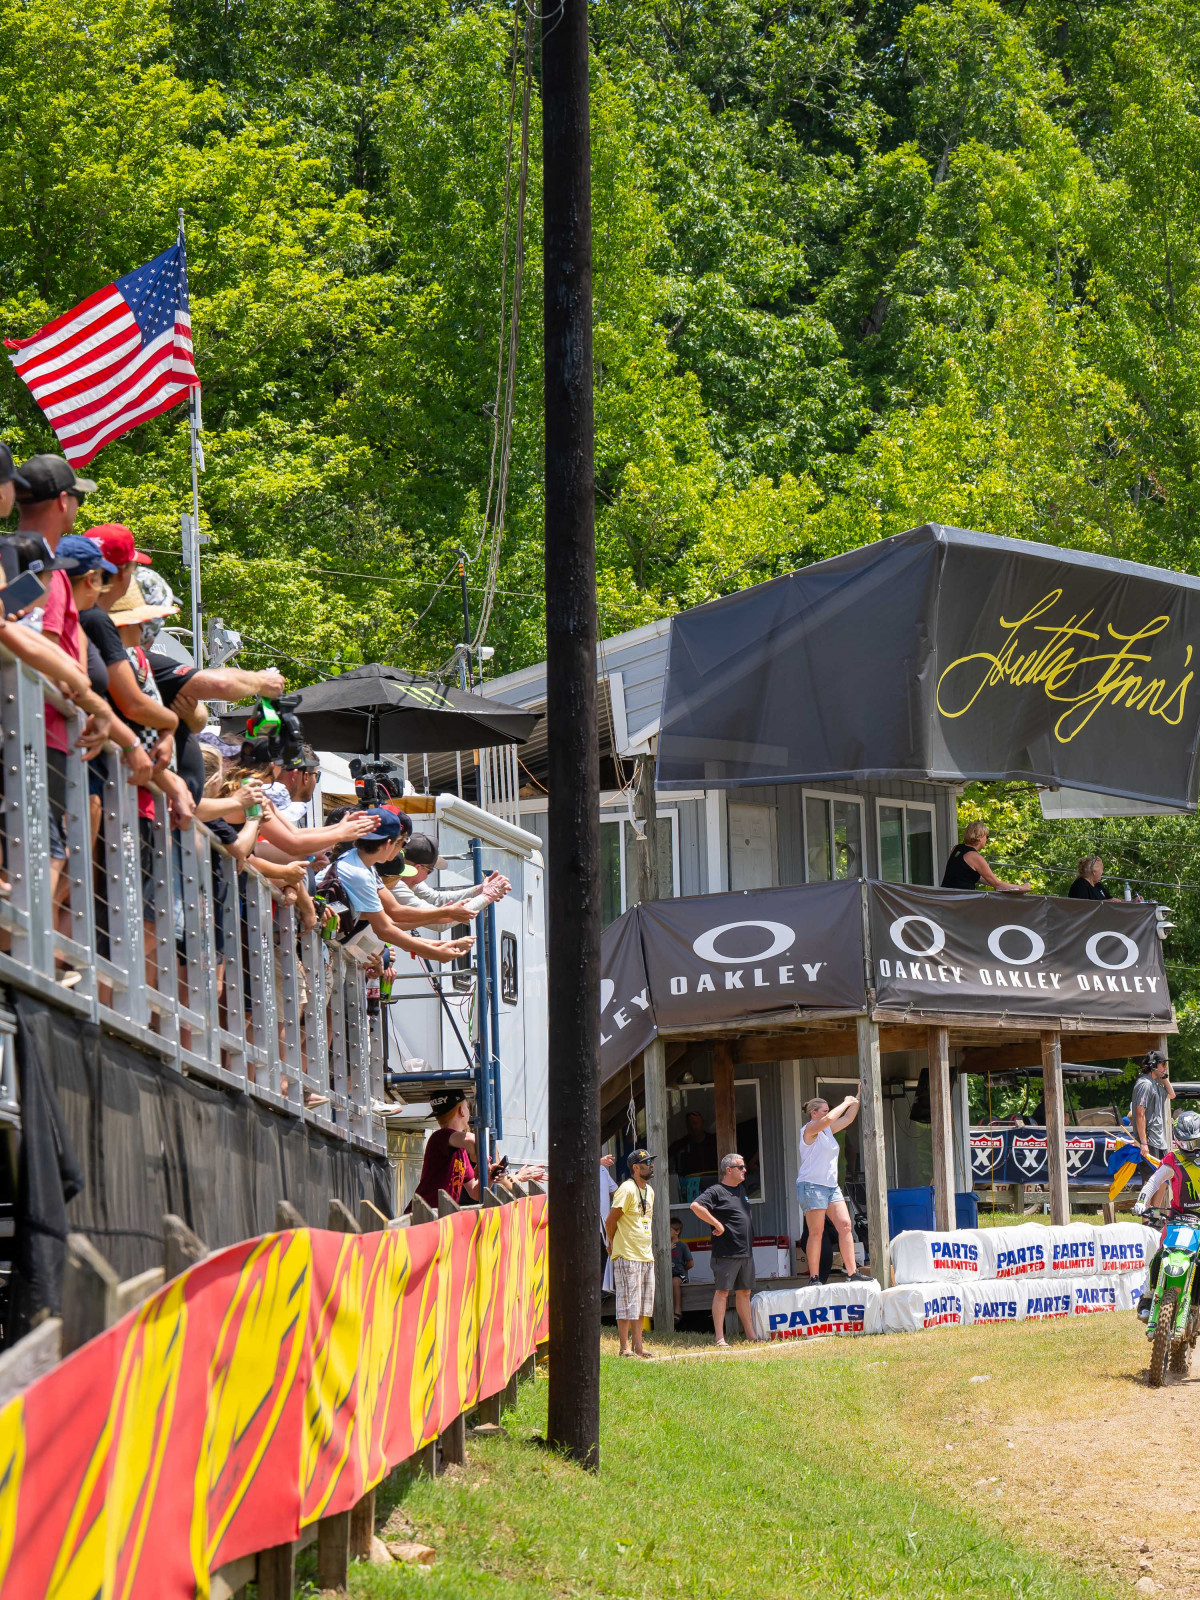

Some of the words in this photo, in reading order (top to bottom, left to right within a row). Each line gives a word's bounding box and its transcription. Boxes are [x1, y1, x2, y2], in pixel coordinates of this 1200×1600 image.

[670, 962, 823, 995] OAKLEY
[879, 958, 963, 984] OAKLEY
[979, 968, 1061, 990] OAKLEY
[1077, 974, 1159, 993] OAKLEY
[973, 1148, 993, 1166] X
[1022, 1149, 1039, 1167] X
[1067, 1150, 1085, 1168] X
[1173, 1226, 1195, 1248] 1
[931, 1242, 978, 1261] PARTS
[997, 1244, 1044, 1269] PARTS
[1053, 1241, 1095, 1260] PARTS
[1100, 1243, 1144, 1260] PARTS
[933, 1259, 978, 1272] UNLIMITED
[995, 1260, 1045, 1279] UNLIMITED
[1102, 1260, 1145, 1271] UNLIMITED
[1027, 1294, 1071, 1315] PARTS
[1075, 1287, 1116, 1304] PARTS
[924, 1296, 962, 1318] PARTS
[974, 1301, 1017, 1318] PARTS
[768, 1304, 865, 1331] PARTS
